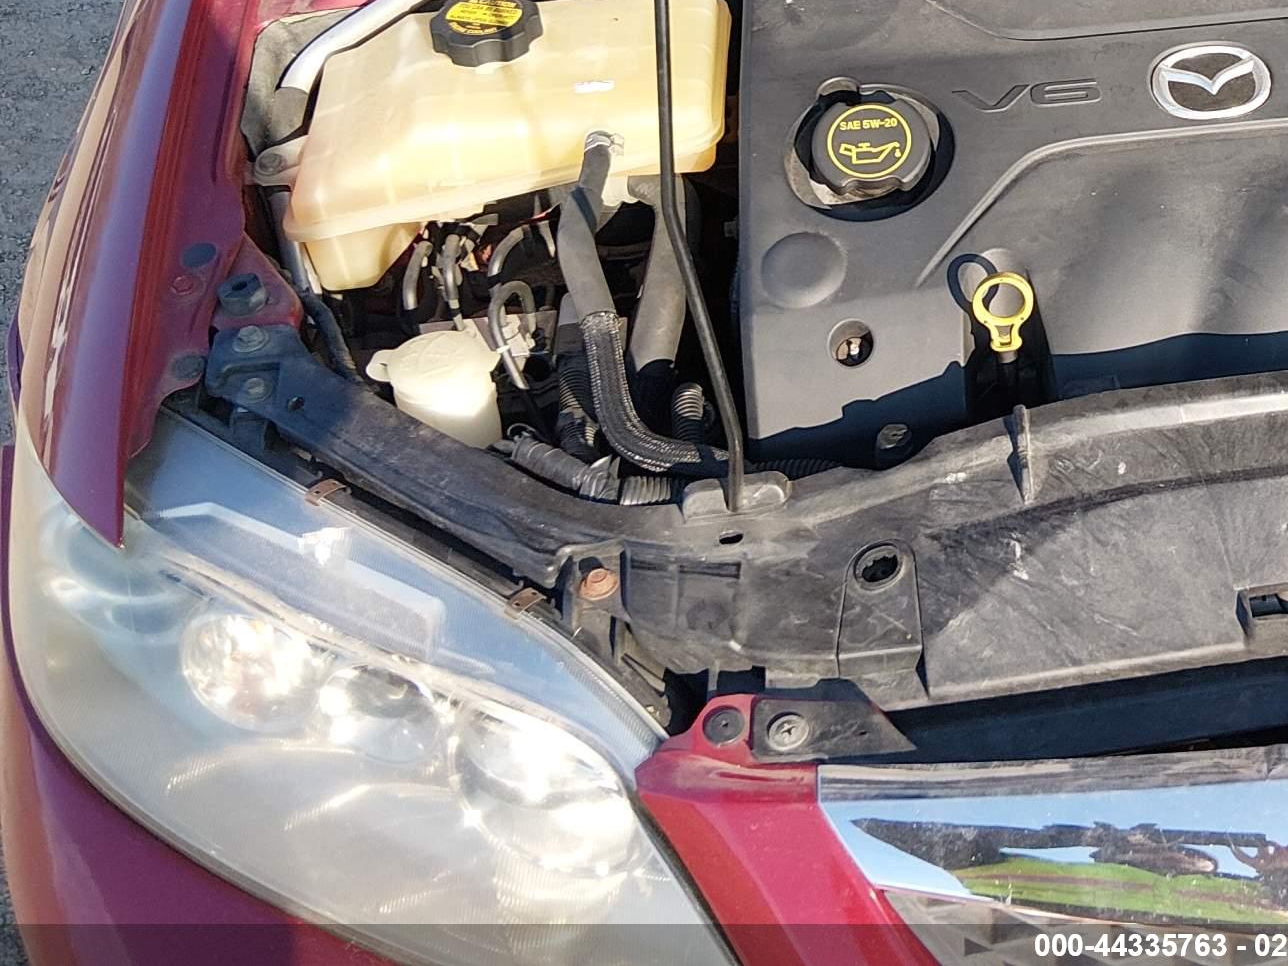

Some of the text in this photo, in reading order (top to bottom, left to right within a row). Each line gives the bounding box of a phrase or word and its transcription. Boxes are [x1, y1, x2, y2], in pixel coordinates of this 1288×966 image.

[951, 78, 1102, 112] V6
[840, 118, 898, 130] SAE 5W-20
